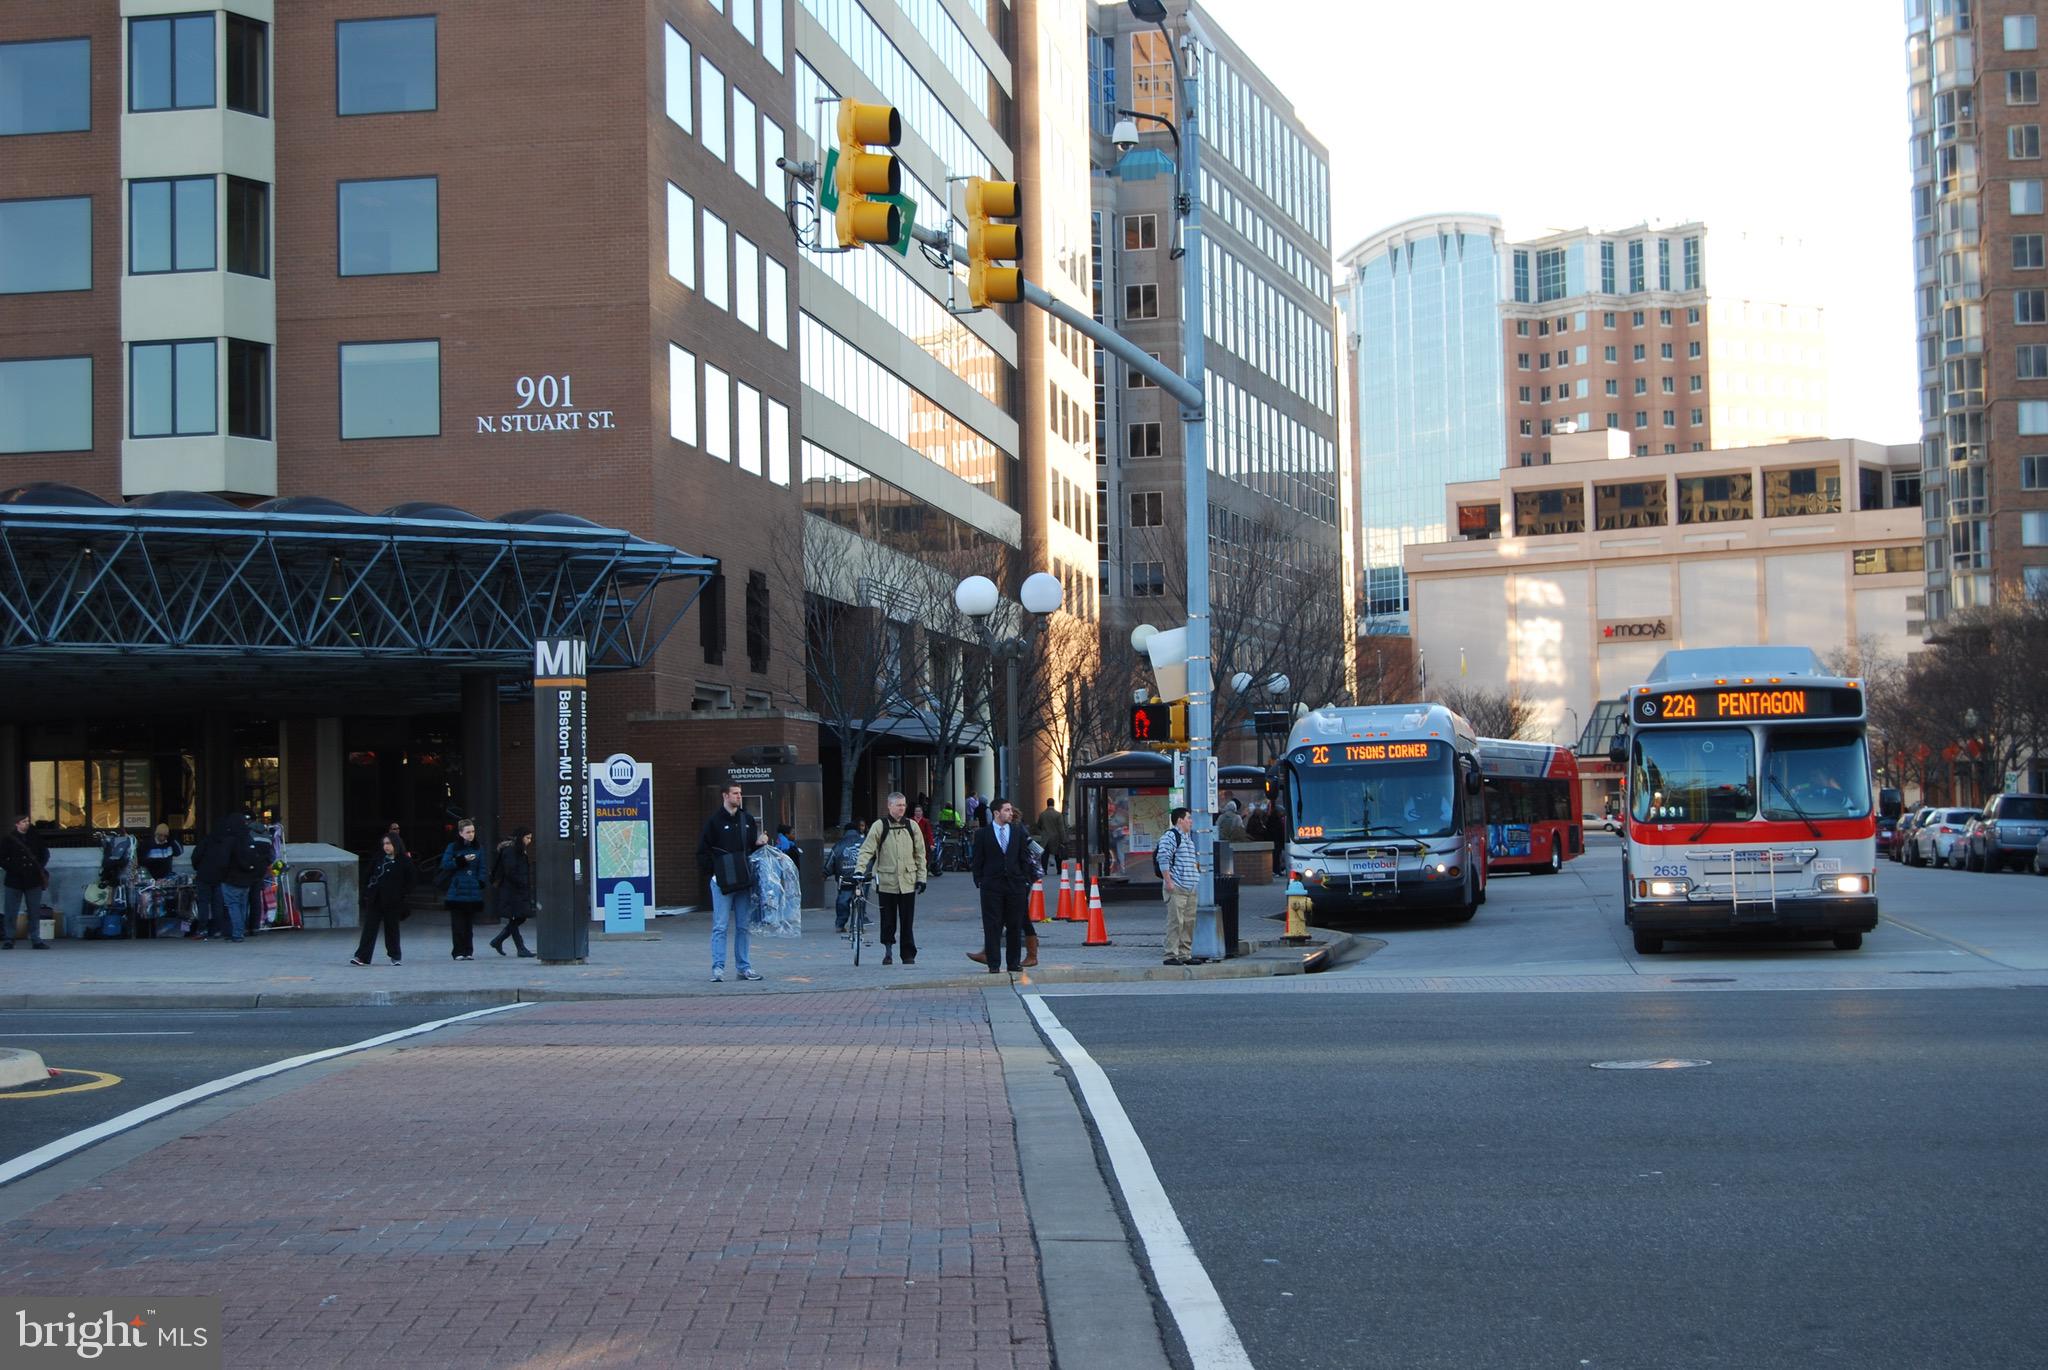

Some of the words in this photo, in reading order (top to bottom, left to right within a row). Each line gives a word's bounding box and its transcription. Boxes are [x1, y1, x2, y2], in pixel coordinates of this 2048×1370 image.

[516, 375, 573, 409] 901
[476, 416, 496, 433] N.
[501, 412, 582, 433] STUART
[588, 411, 615, 429] ST.
[1615, 619, 1666, 638] macy's
[536, 640, 570, 675] M
[573, 639, 587, 675] M
[1662, 694, 1696, 717] 22A
[1718, 691, 1805, 716] PENTAGON
[559, 690, 572, 780] Ballston-MU
[1312, 746, 1329, 764] 2C
[1346, 745, 1385, 760] TYSONS
[1388, 743, 1428, 759] CORNER
[728, 766, 772, 774] metrobus
[559, 785, 572, 838] Station
[596, 807, 638, 817] BALLSTON
[1298, 826, 1323, 837] A218
[1653, 865, 1688, 876] 2635
